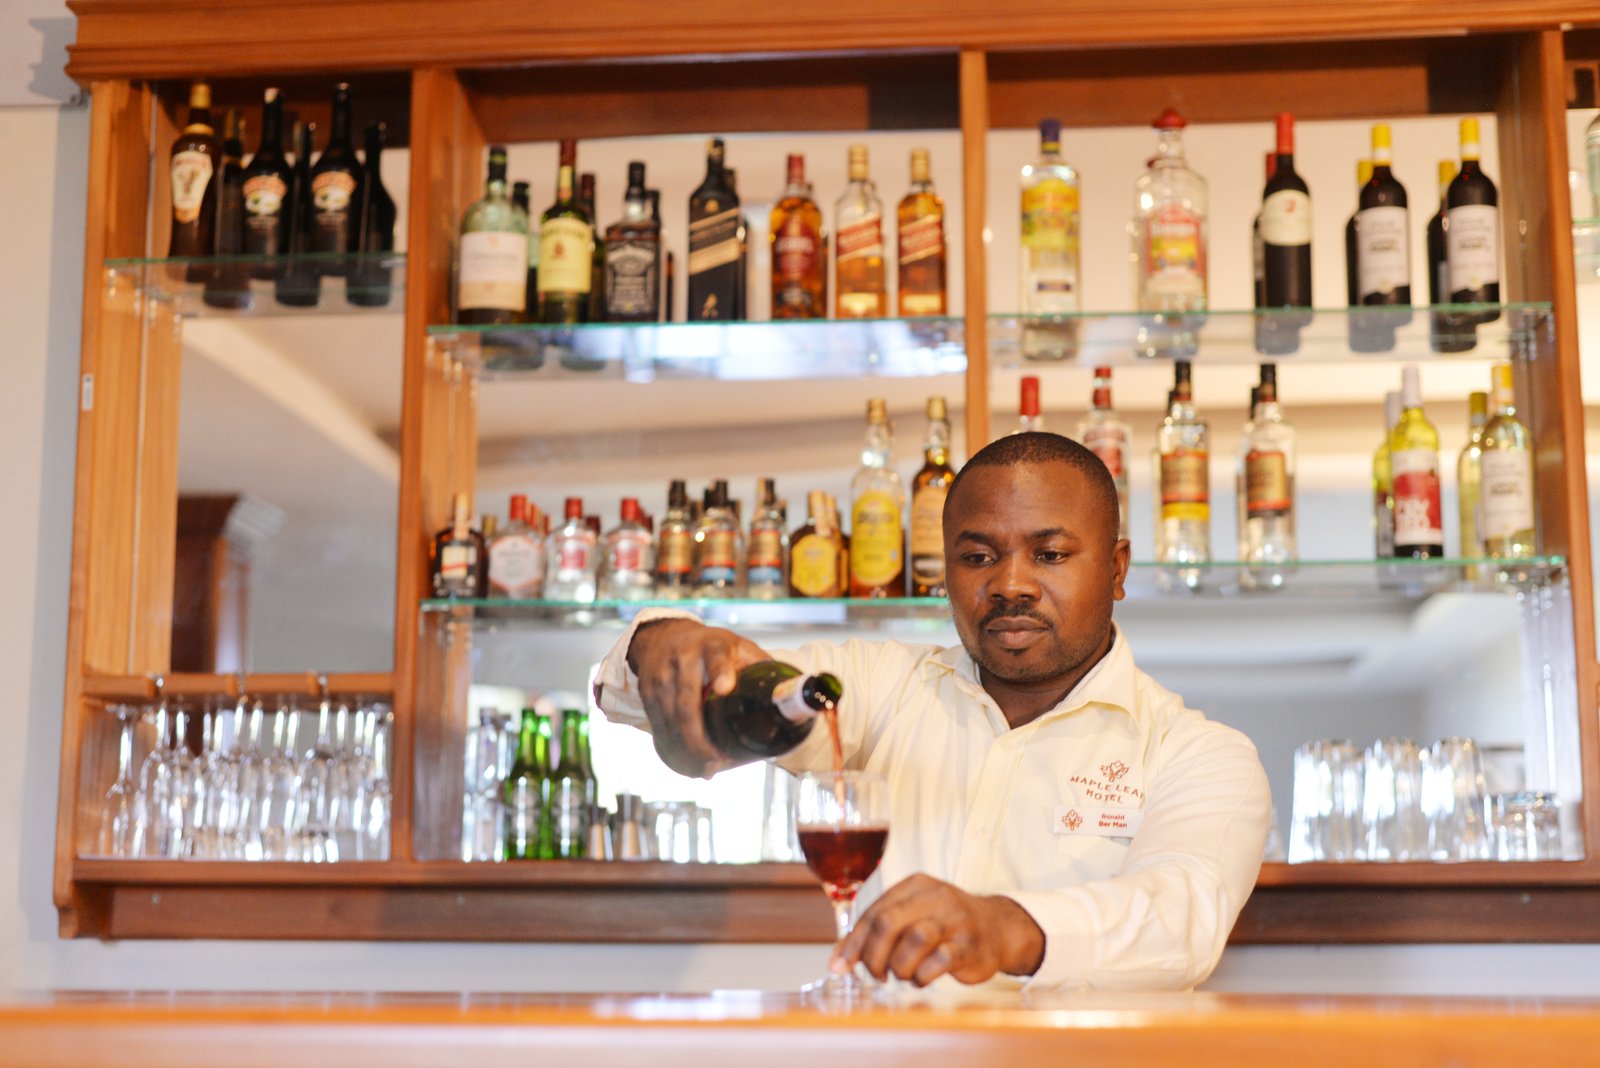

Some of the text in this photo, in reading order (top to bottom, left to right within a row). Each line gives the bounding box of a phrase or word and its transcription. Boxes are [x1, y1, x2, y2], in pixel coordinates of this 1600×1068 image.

[1070, 776, 1111, 791] MAPLE
[1086, 789, 1122, 803] HOTEL
[1101, 813, 1125, 821] Ronald
